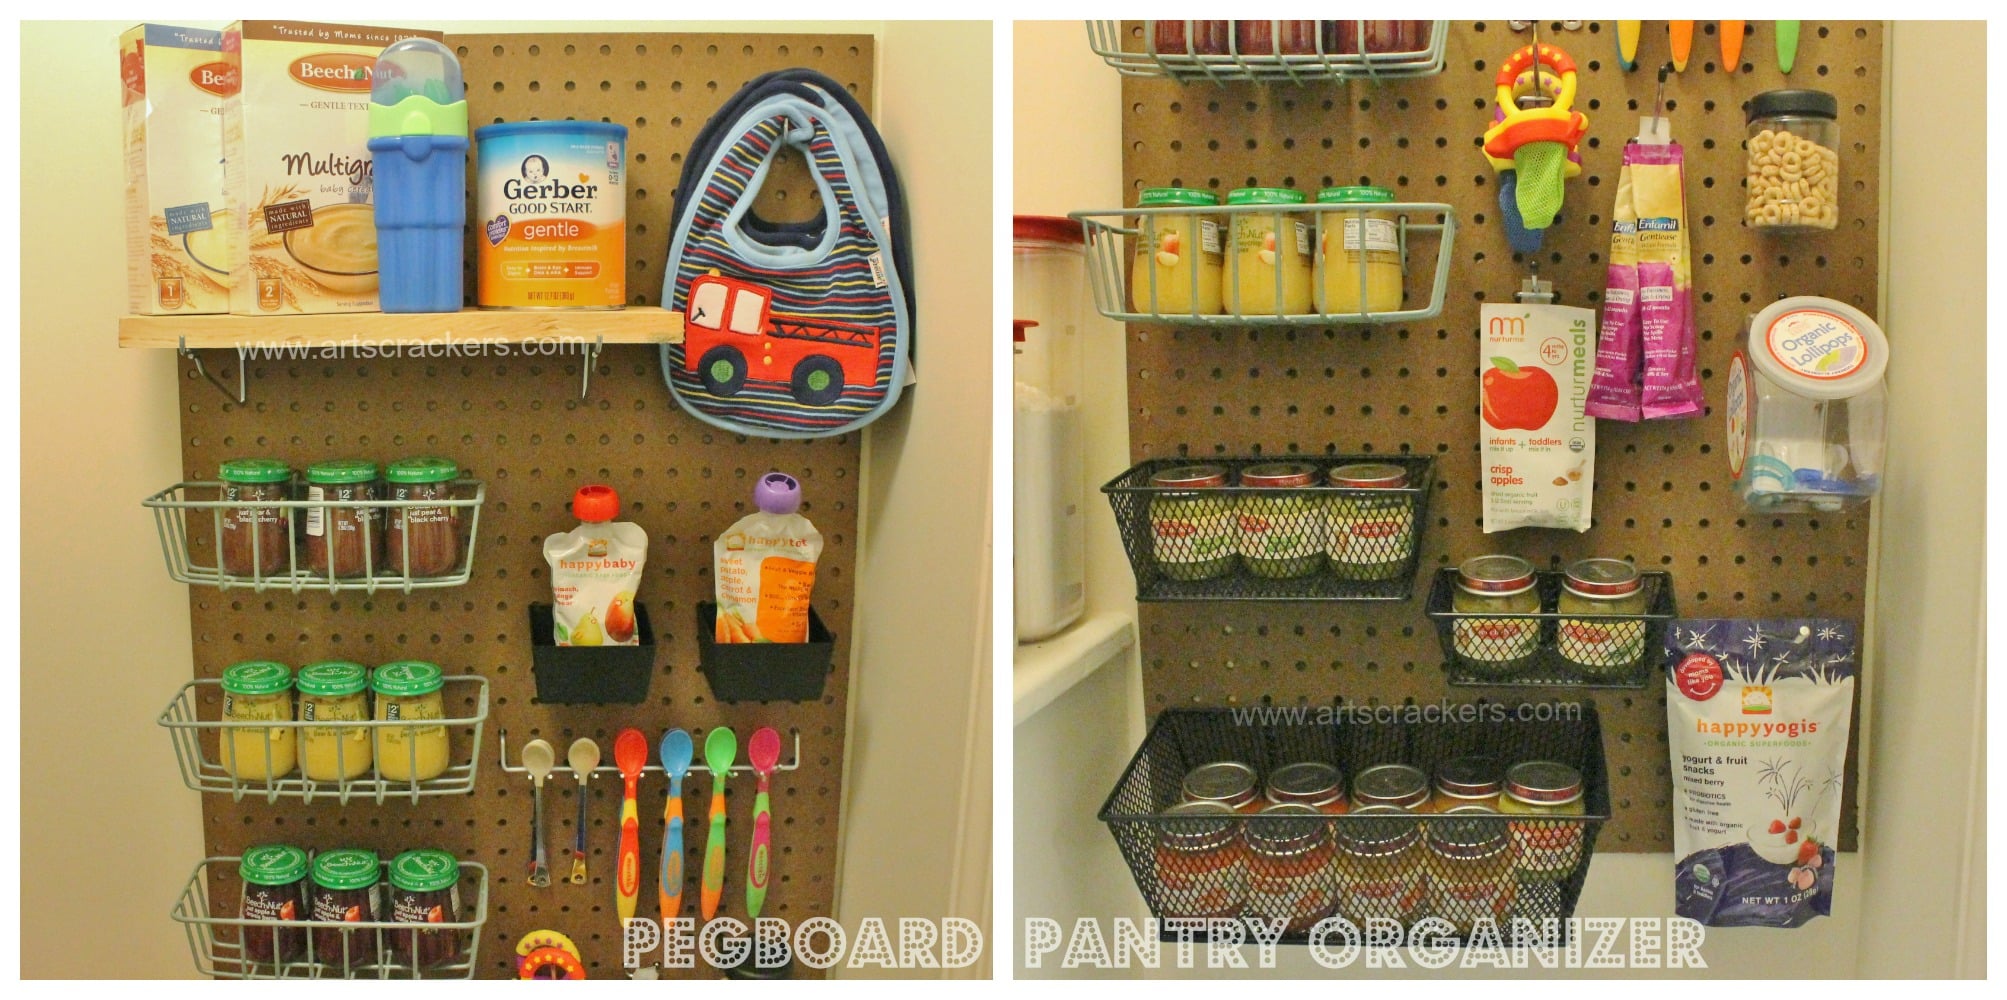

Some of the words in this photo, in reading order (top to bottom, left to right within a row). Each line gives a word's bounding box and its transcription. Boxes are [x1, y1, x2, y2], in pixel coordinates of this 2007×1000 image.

[318, 30, 330, 40] by
[333, 30, 361, 40] Moms
[366, 34, 390, 42] since
[310, 101, 346, 110] GENTLE
[319, 184, 344, 196] baby
[503, 178, 598, 200] Gerber
[509, 202, 548, 214] GOOD
[170, 213, 208, 225] NATURAL
[269, 210, 308, 224] NATURAL
[270, 218, 310, 231] ingredients
[523, 220, 580, 241] gentle
[1638, 219, 1677, 230] Enfamil
[265, 285, 274, 298] 2
[1780, 321, 1837, 352] Organic
[1542, 344, 1552, 359] 4
[1790, 331, 1854, 367] Lollipops
[1569, 319, 1586, 432] nurturmeals
[1489, 436, 1517, 446] infants
[1528, 437, 1562, 446] toddlers
[1490, 464, 1513, 475] crisp
[1490, 475, 1524, 487] apples
[258, 515, 278, 524] cherry
[429, 514, 449, 523] cherry
[720, 557, 743, 566] sweet
[720, 566, 749, 576] potato,
[720, 575, 745, 586] apple,
[721, 584, 744, 593] carrot
[721, 593, 758, 604] cinnamon
[1688, 668, 1709, 678] moms
[1687, 678, 1700, 686] like
[1700, 674, 1714, 684] you
[1696, 718, 1818, 738] happyyogis
[1682, 754, 1712, 766] yogurt
[1715, 756, 1723, 765] &
[1726, 756, 1748, 765] fruit
[1683, 764, 1715, 776] snacks
[1683, 775, 1703, 785] mixed
[1704, 778, 1725, 788] berry
[1688, 806, 1706, 815] gluten
[1719, 821, 1744, 829] organic
[1706, 827, 1727, 836] yogurt
[1742, 896, 1761, 905] NET
[1764, 896, 1780, 905] WT
[1791, 894, 1803, 904] OZ
